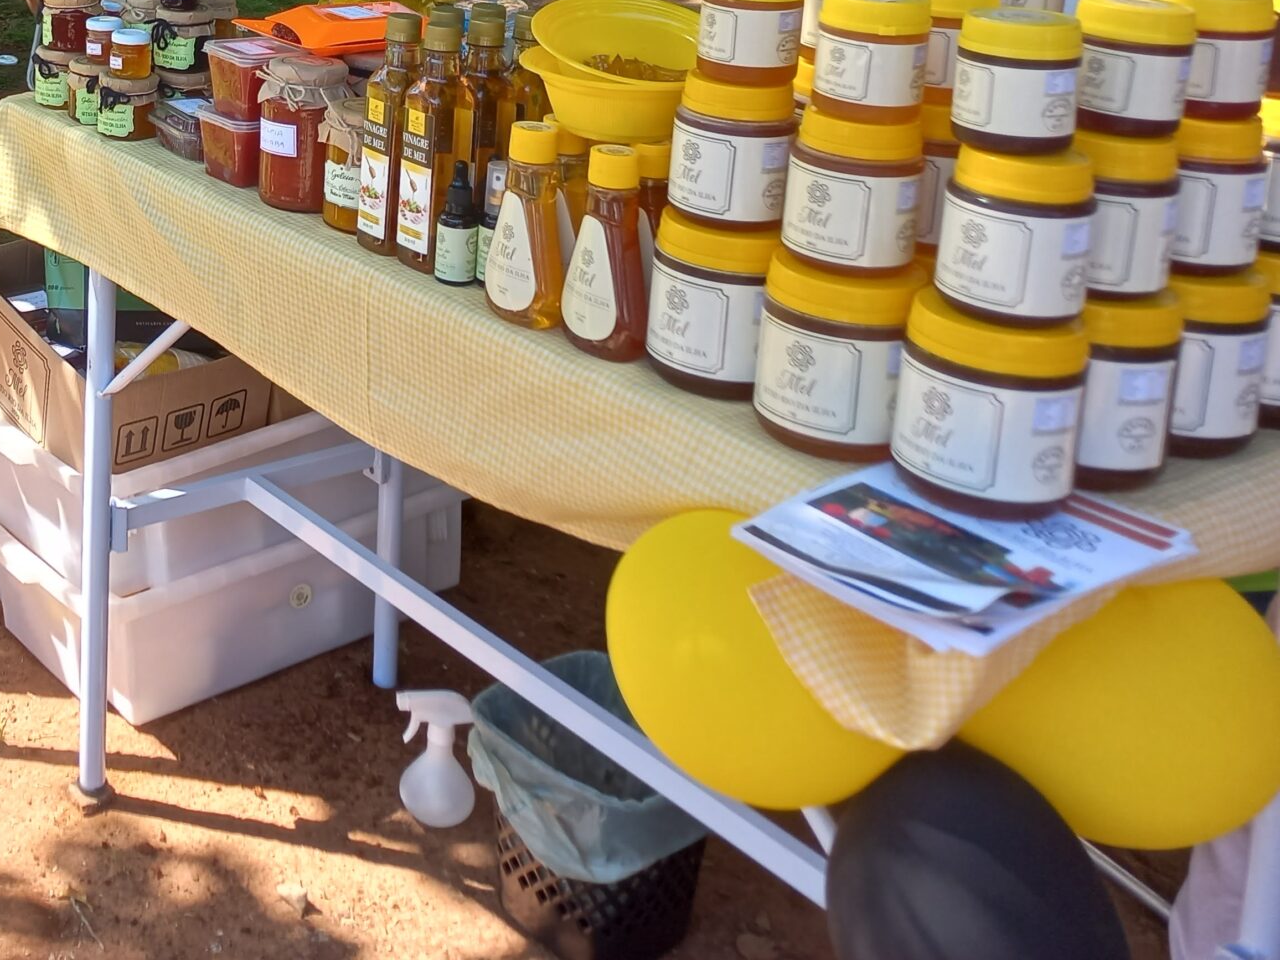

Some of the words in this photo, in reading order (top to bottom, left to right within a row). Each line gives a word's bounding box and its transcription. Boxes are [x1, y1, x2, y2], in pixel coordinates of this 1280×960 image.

[364, 120, 388, 138] VINAGRE
[364, 134, 373, 146] DE
[372, 137, 386, 151] MEL
[403, 131, 430, 150] VINAGRE
[404, 146, 413, 158] DE
[413, 150, 428, 163] MEL
[5, 368, 28, 401] Mel
